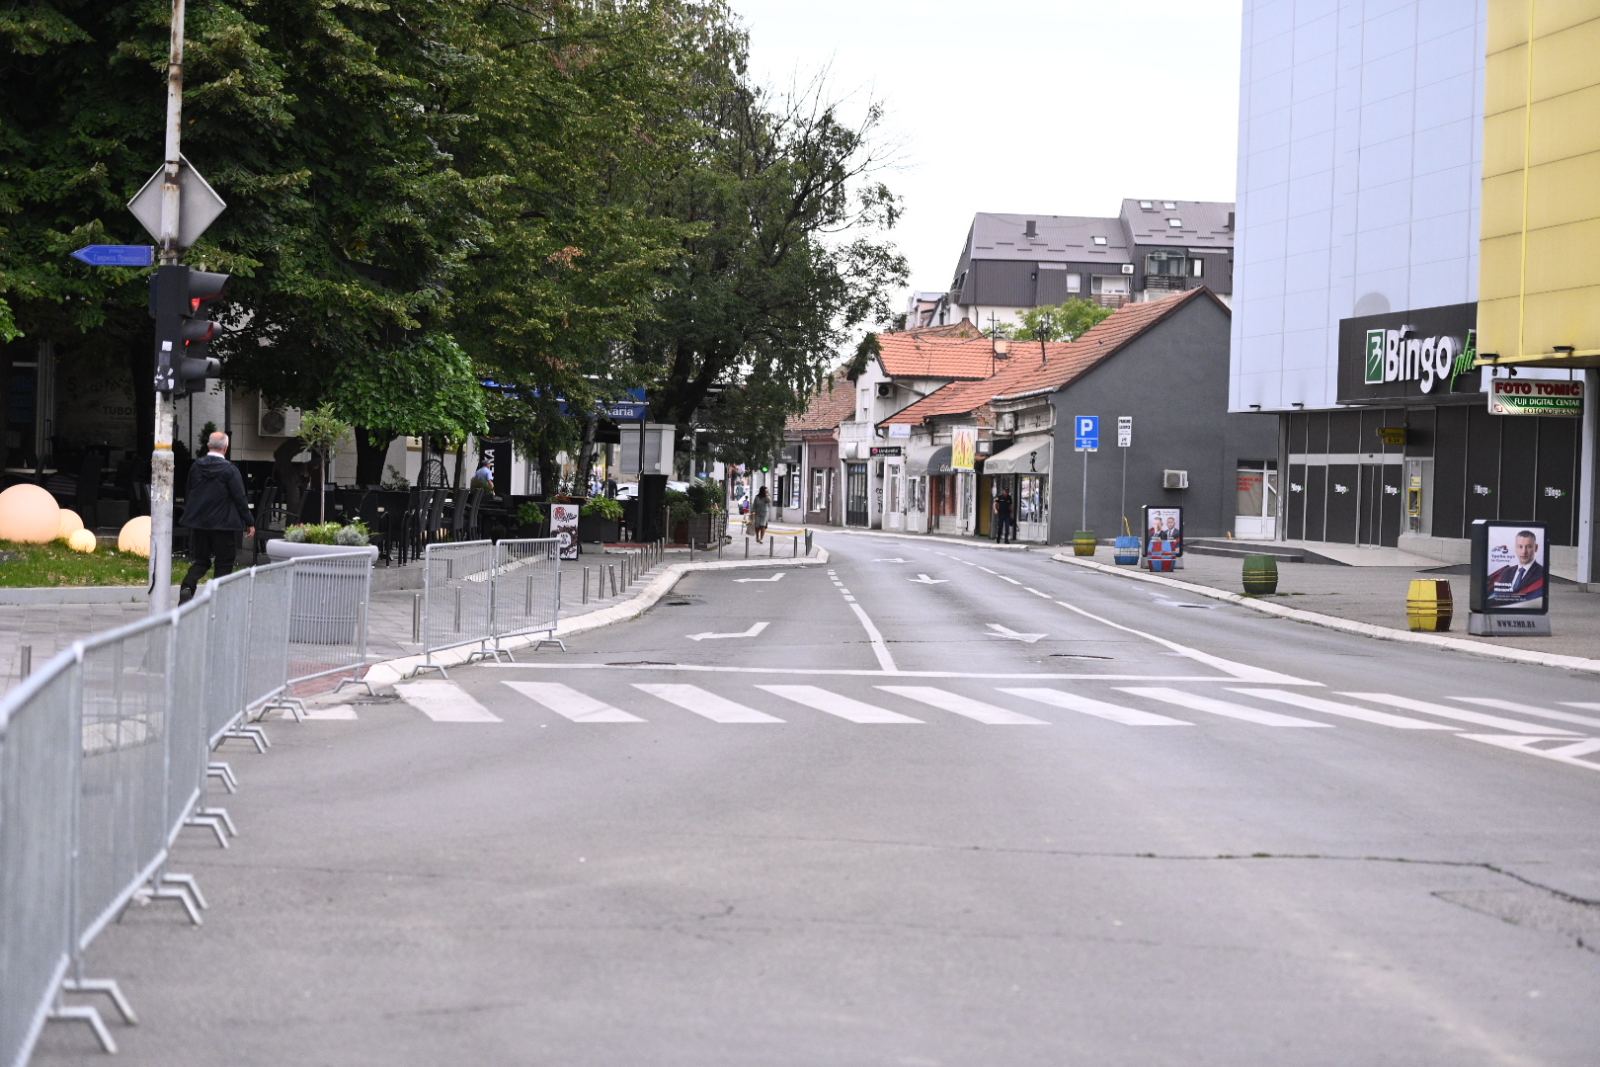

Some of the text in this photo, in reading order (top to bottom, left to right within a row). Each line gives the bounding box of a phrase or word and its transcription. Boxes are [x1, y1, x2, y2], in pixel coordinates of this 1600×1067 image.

[1385, 324, 1453, 394] Bingo
[1494, 382, 1532, 394] FOTO
[1514, 397, 1527, 406] FUJI
[1529, 398, 1554, 406] DIGITAL
[1081, 419, 1093, 436] P
